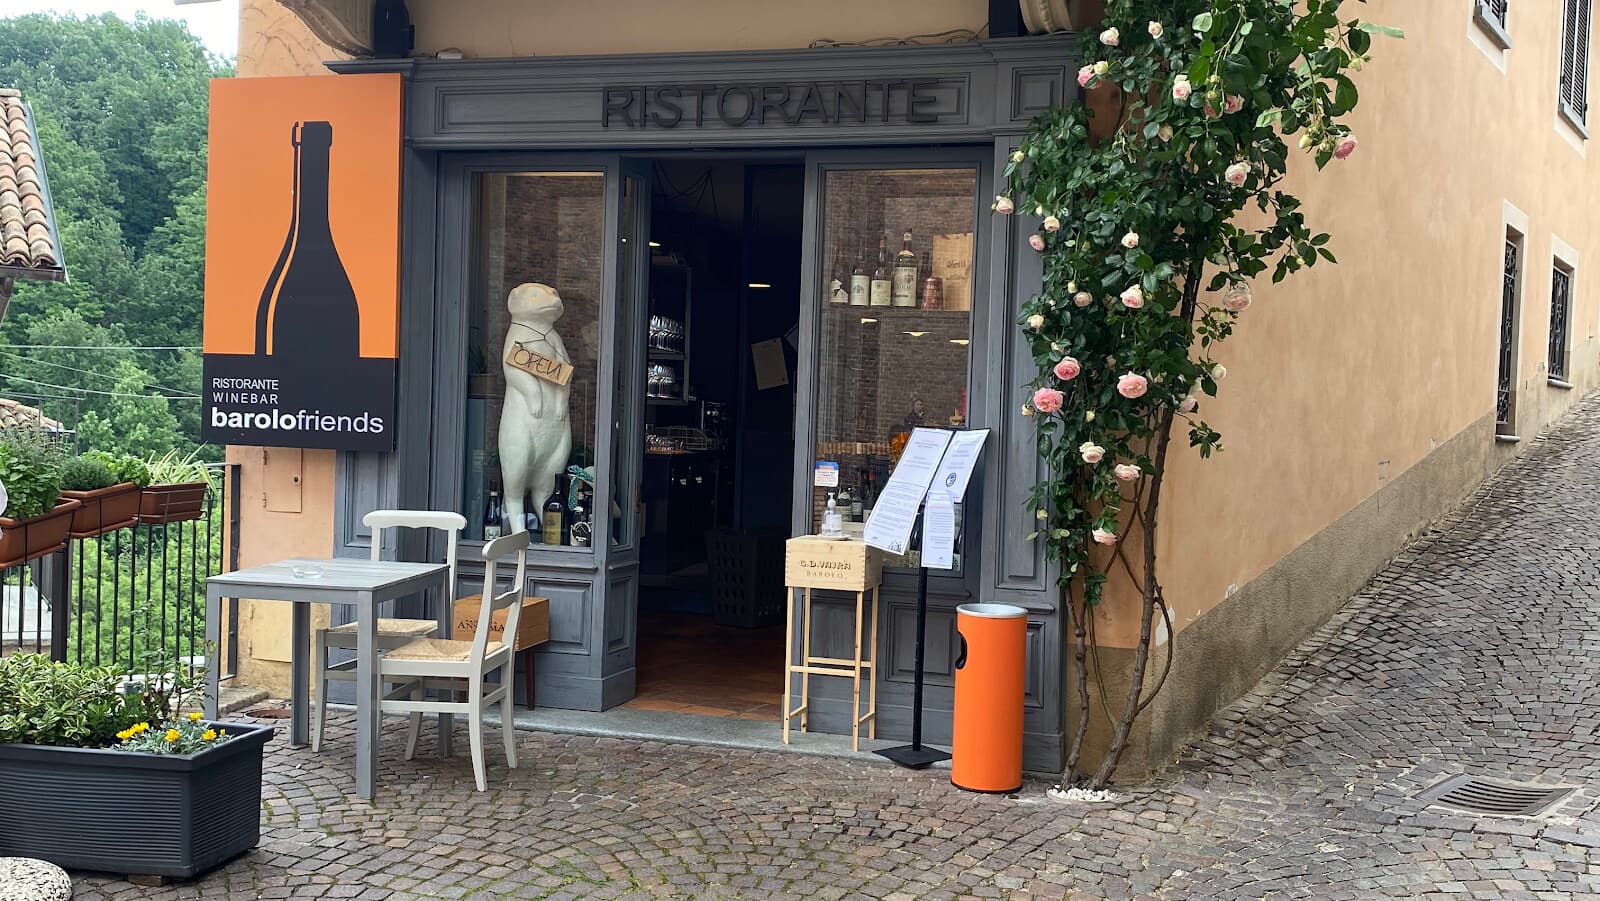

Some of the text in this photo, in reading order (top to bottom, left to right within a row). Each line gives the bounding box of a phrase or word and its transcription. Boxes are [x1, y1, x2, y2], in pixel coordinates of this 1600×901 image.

[601, 78, 939, 128] RISTORANTE
[514, 349, 562, 381] OPEN
[212, 377, 279, 390] RISTORANTE
[212, 391, 279, 405] WINEBAR
[211, 406, 384, 433] barolofriends
